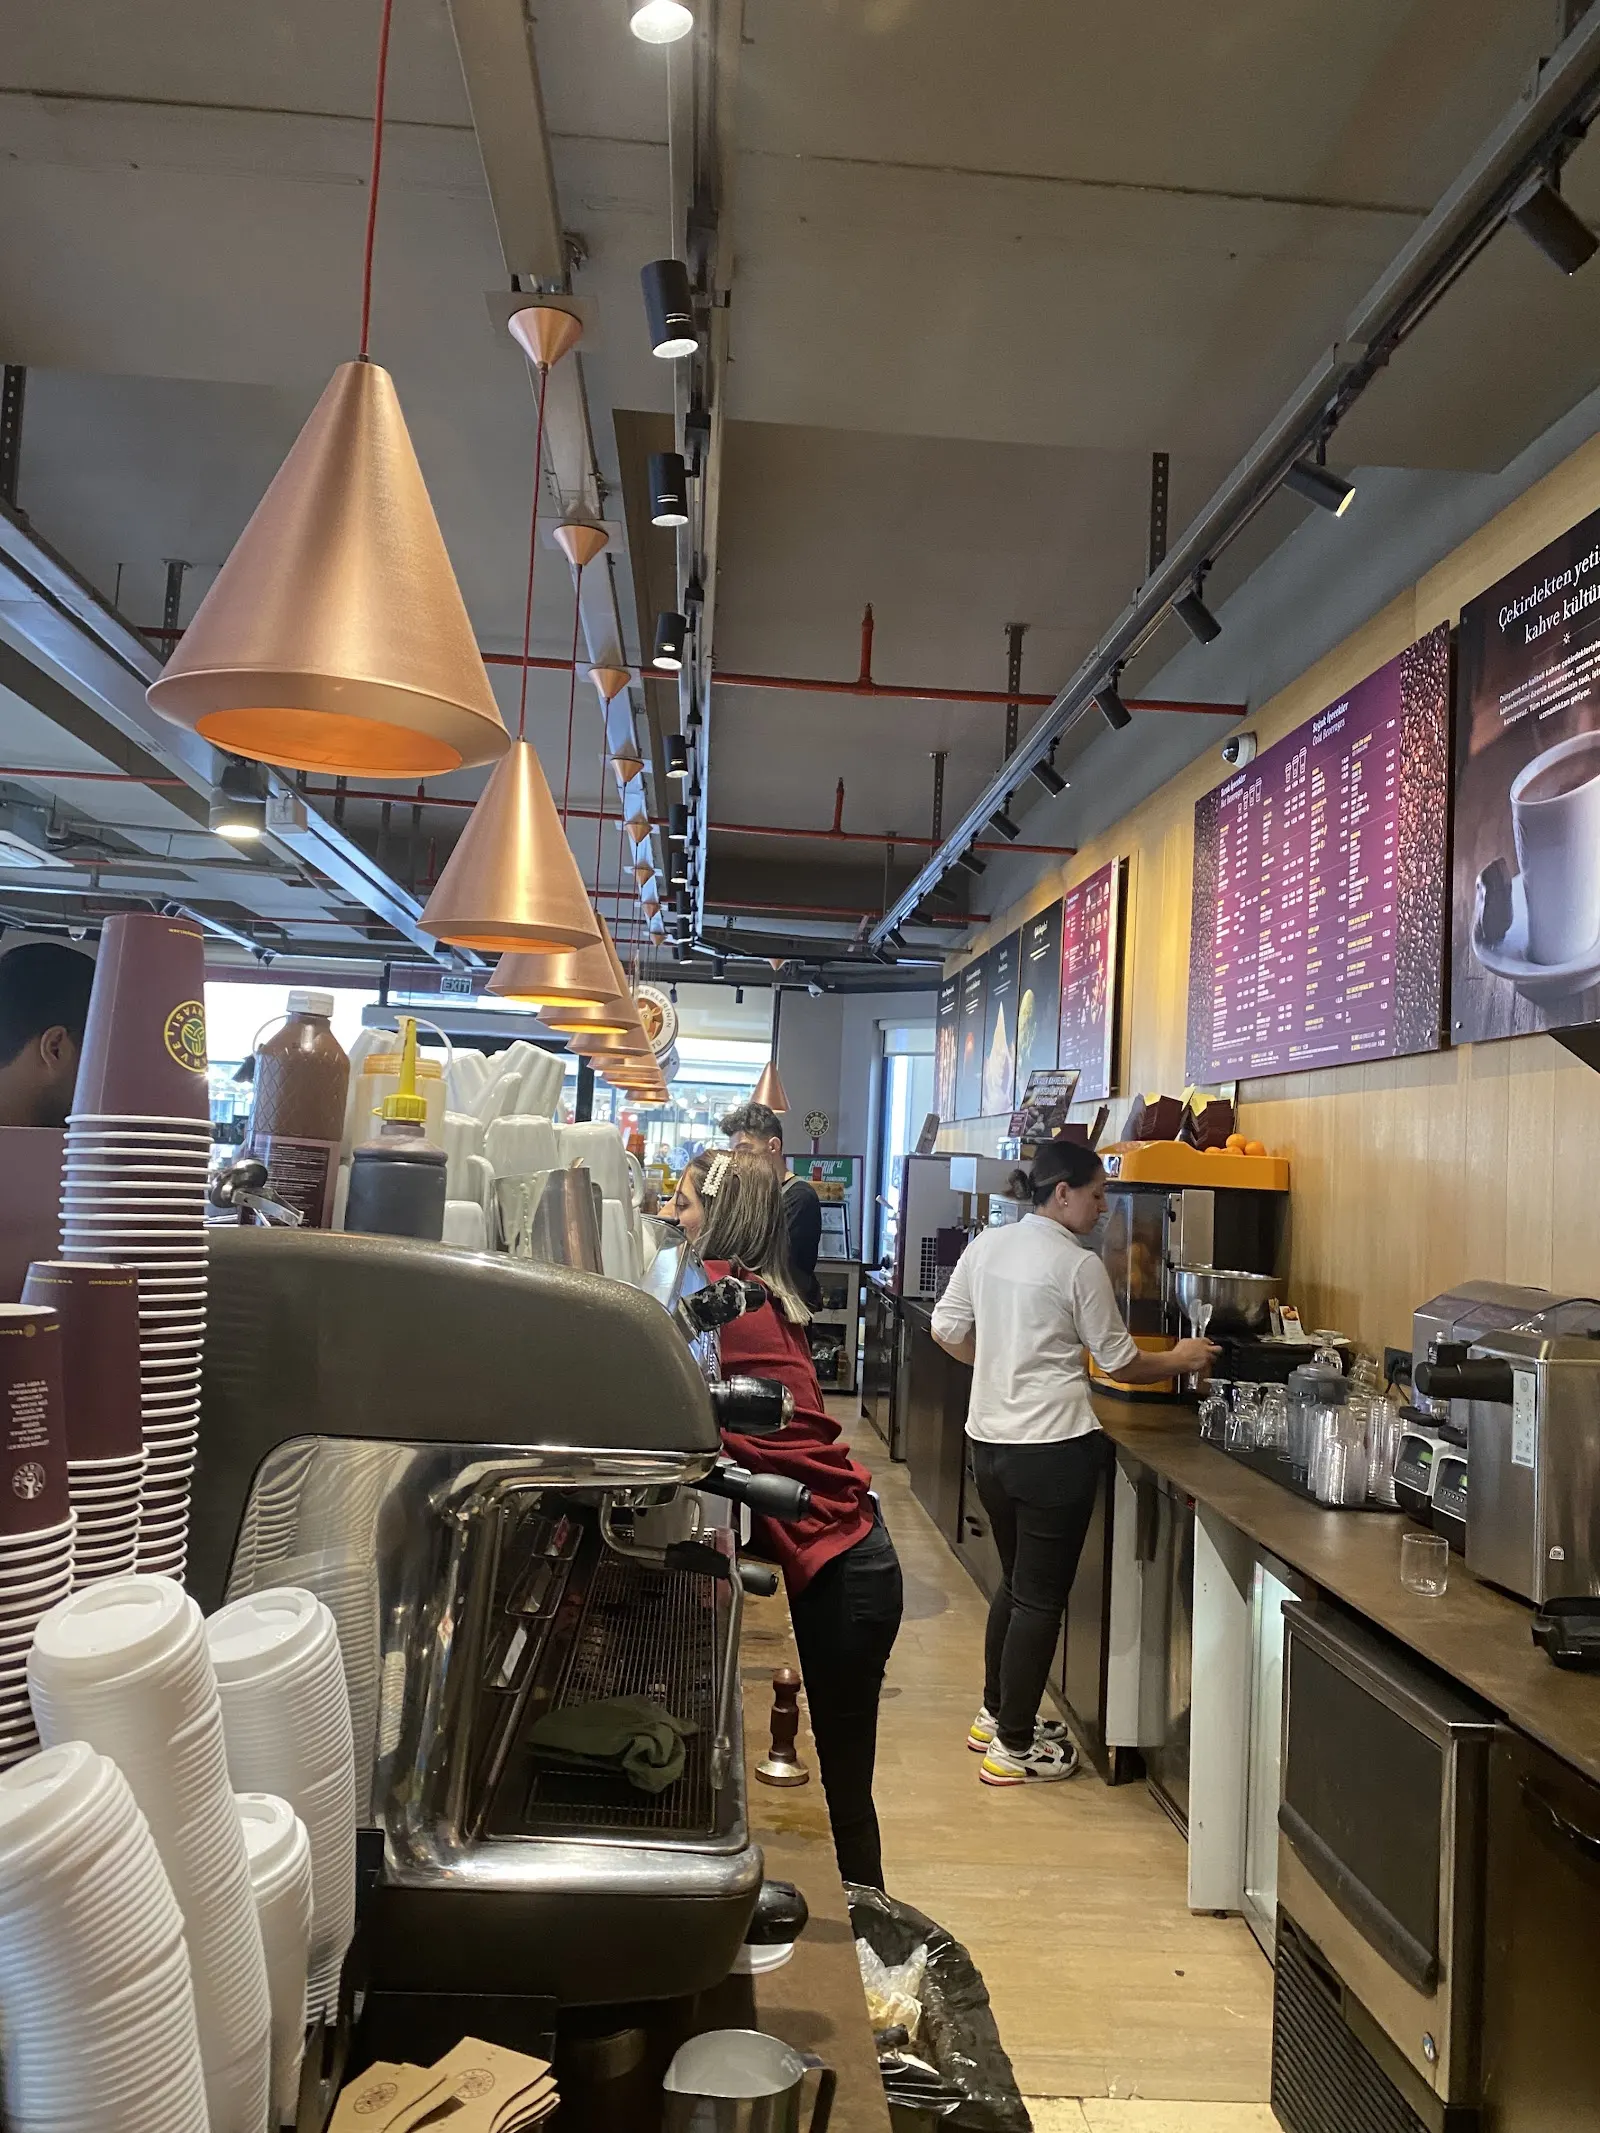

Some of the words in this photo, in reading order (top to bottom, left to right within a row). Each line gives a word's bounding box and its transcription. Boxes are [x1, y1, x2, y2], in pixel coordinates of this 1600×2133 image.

[1499, 569, 1572, 632] Çekirdekten
[1573, 544, 1600, 587] yeti
[1525, 610, 1560, 644] kahve
[1545, 663, 1561, 677] kahve
[1576, 658, 1593, 674] aroma
[1312, 732, 1322, 746] Cold
[1323, 718, 1345, 740] Beverages
[443, 980, 470, 992] EXIT
